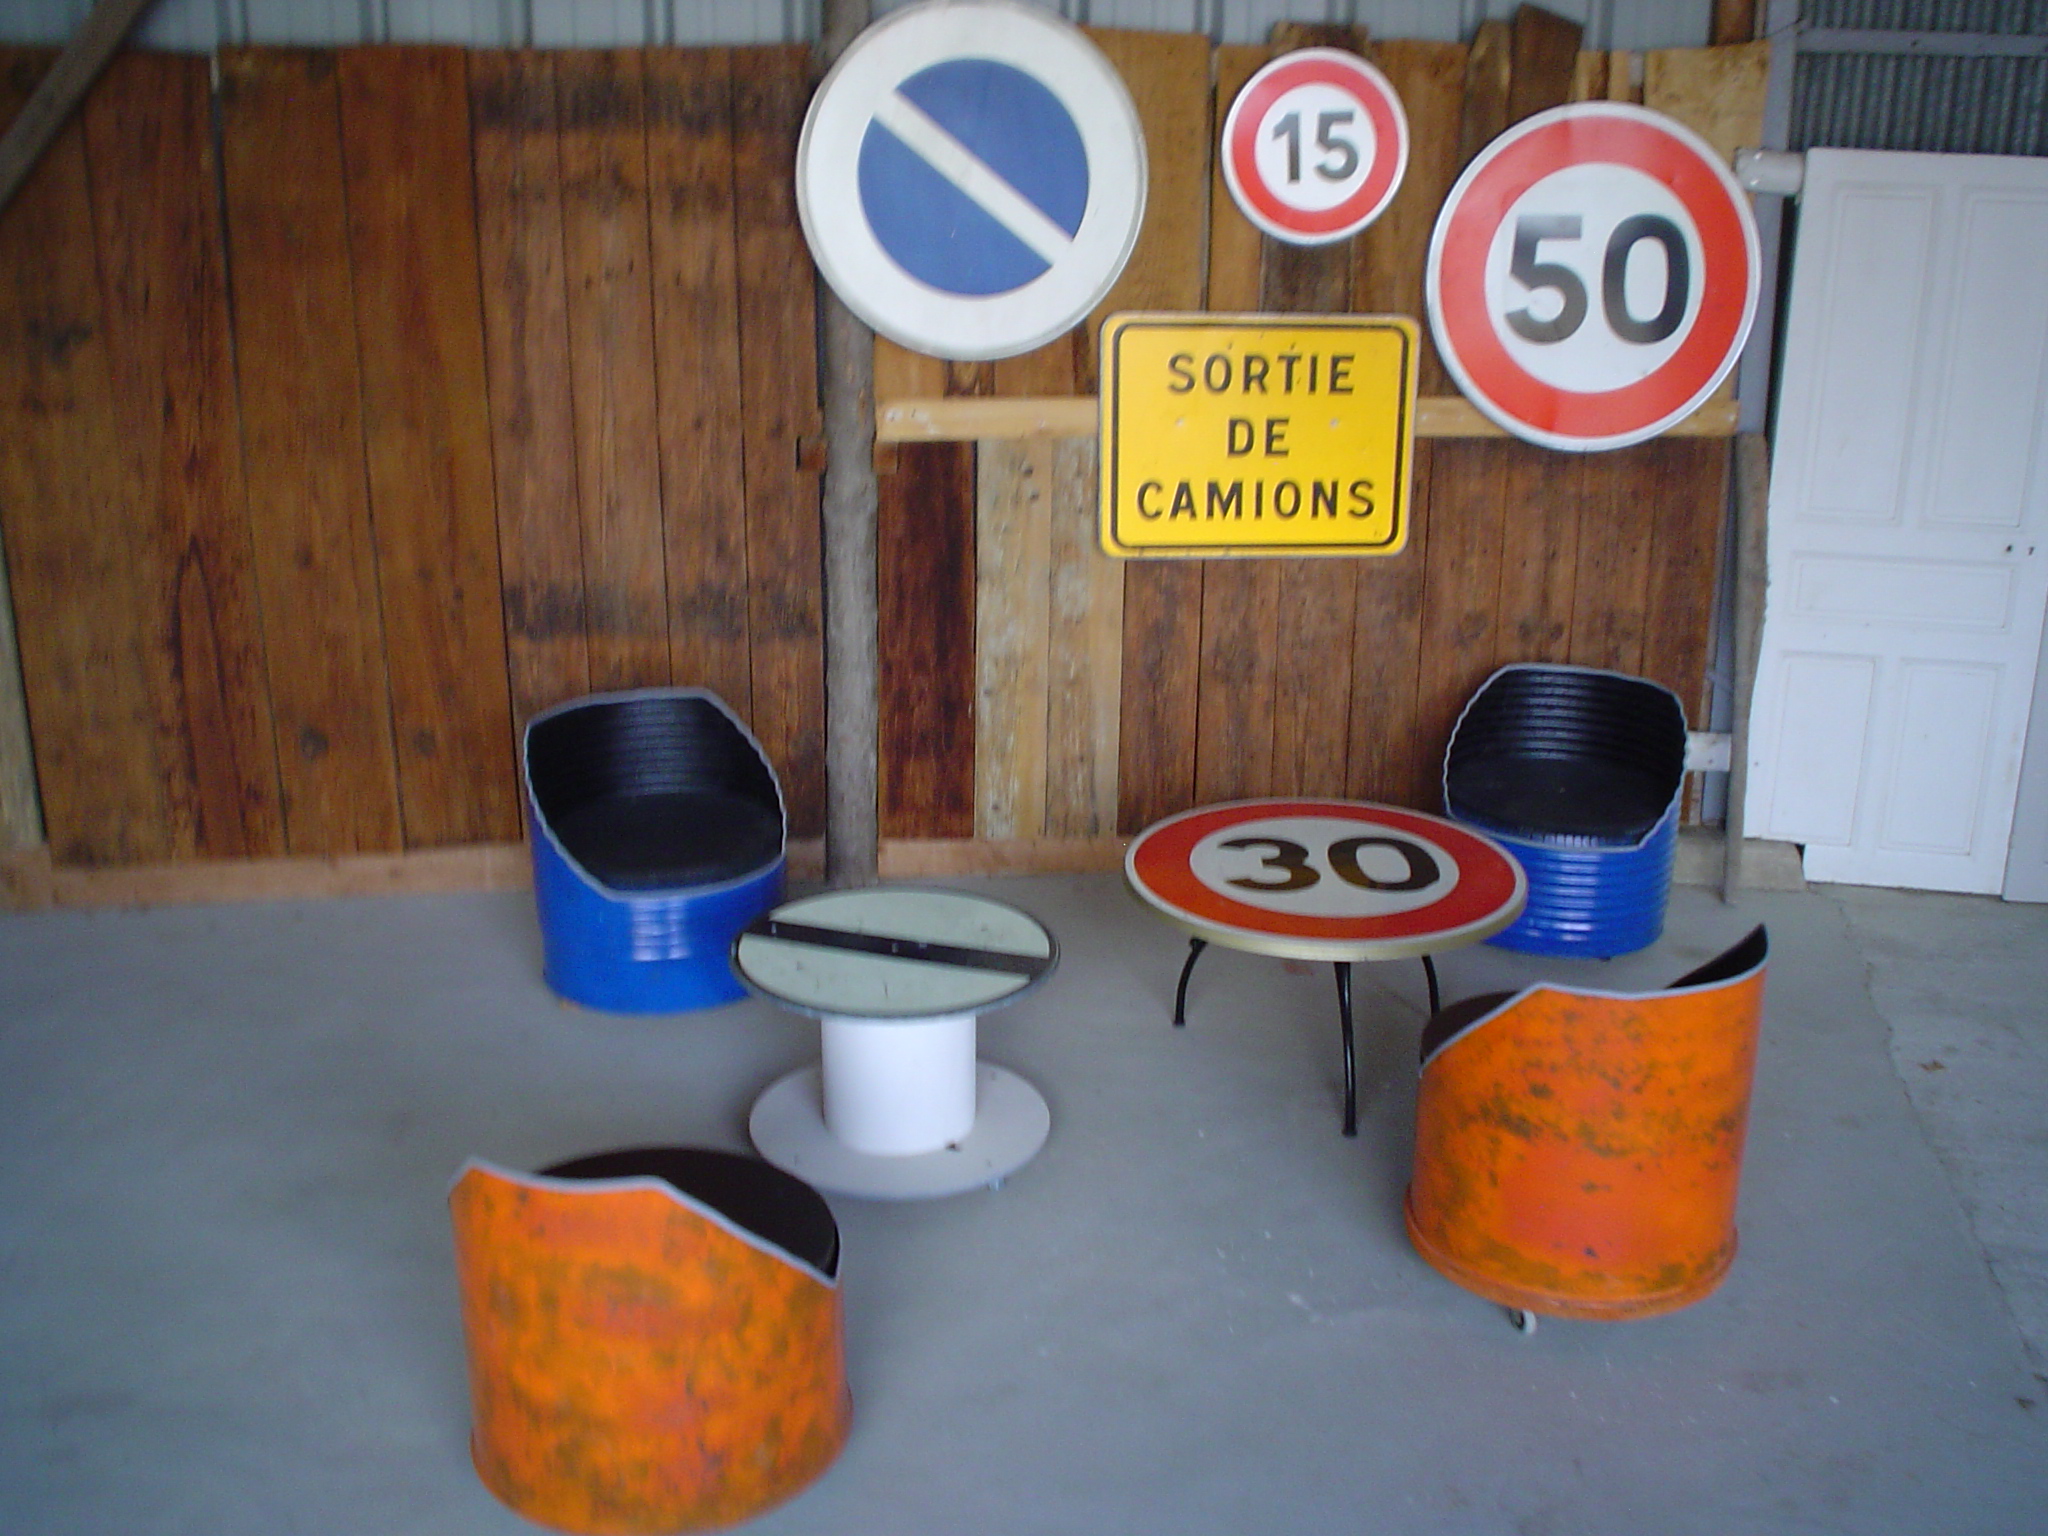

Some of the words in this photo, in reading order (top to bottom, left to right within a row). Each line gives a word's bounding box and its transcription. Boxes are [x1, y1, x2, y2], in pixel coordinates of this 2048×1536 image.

[1271, 110, 1359, 184] 15
[1504, 213, 1690, 345] 50
[1168, 352, 1355, 395] SORTIE
[1227, 417, 1290, 458] DE
[1137, 480, 1375, 522] CAMIONS
[1218, 836, 1441, 893] 30
